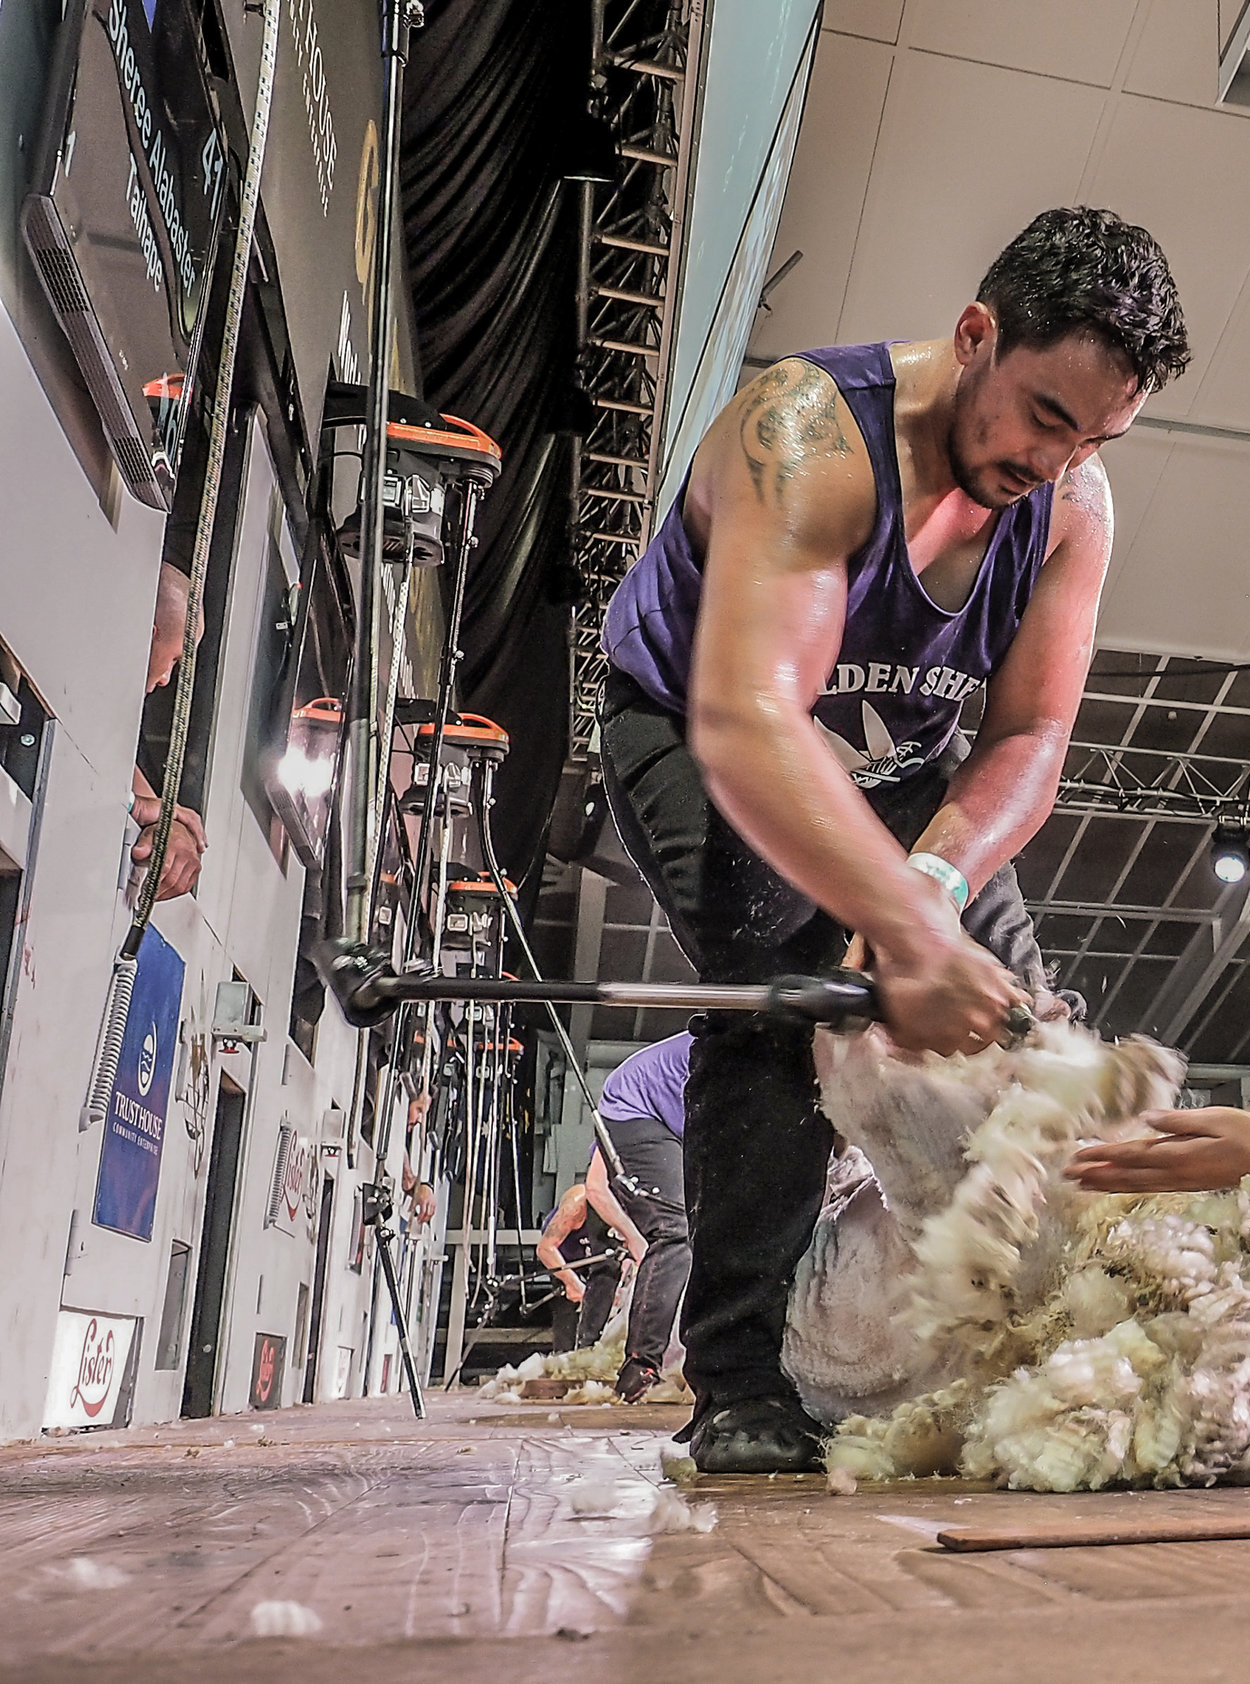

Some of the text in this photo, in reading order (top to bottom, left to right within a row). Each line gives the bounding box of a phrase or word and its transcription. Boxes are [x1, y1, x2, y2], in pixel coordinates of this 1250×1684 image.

[109, 0, 196, 298] Sheree Alabaster
[126, 153, 164, 292] Taihape
[70, 1318, 115, 1417] Lister
